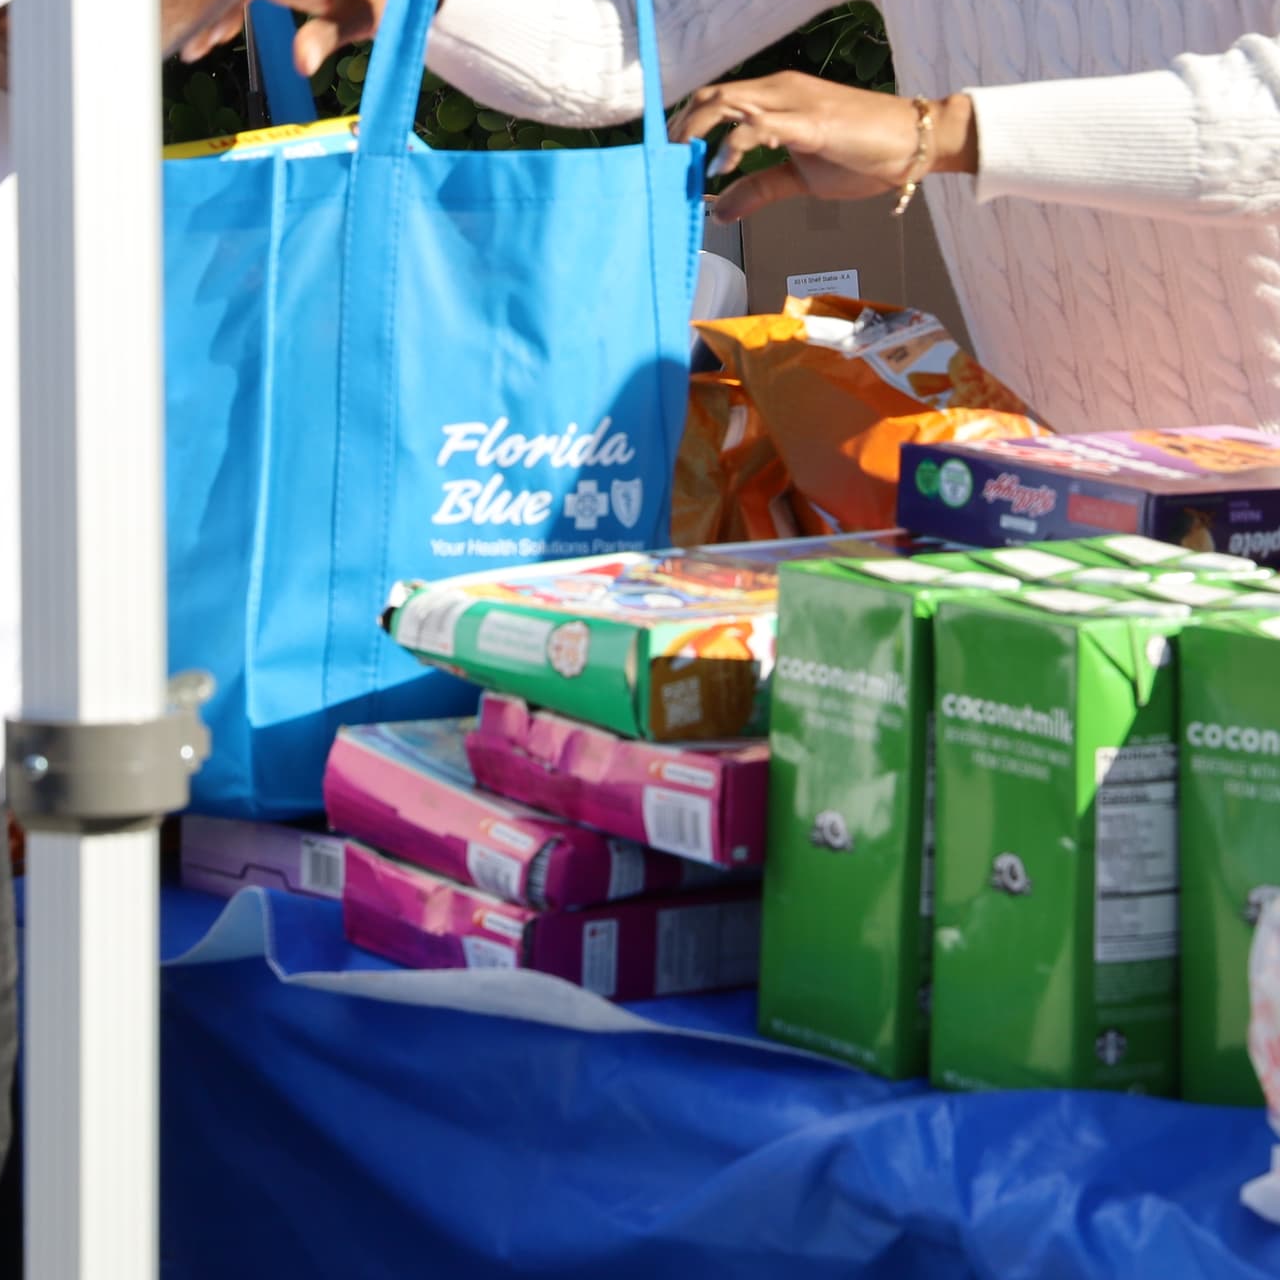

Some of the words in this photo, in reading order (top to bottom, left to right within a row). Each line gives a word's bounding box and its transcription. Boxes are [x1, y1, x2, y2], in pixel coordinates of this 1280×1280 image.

[436, 415, 635, 469] Florida
[431, 472, 553, 527] Blue
[941, 692, 1074, 745] coconutmilk
